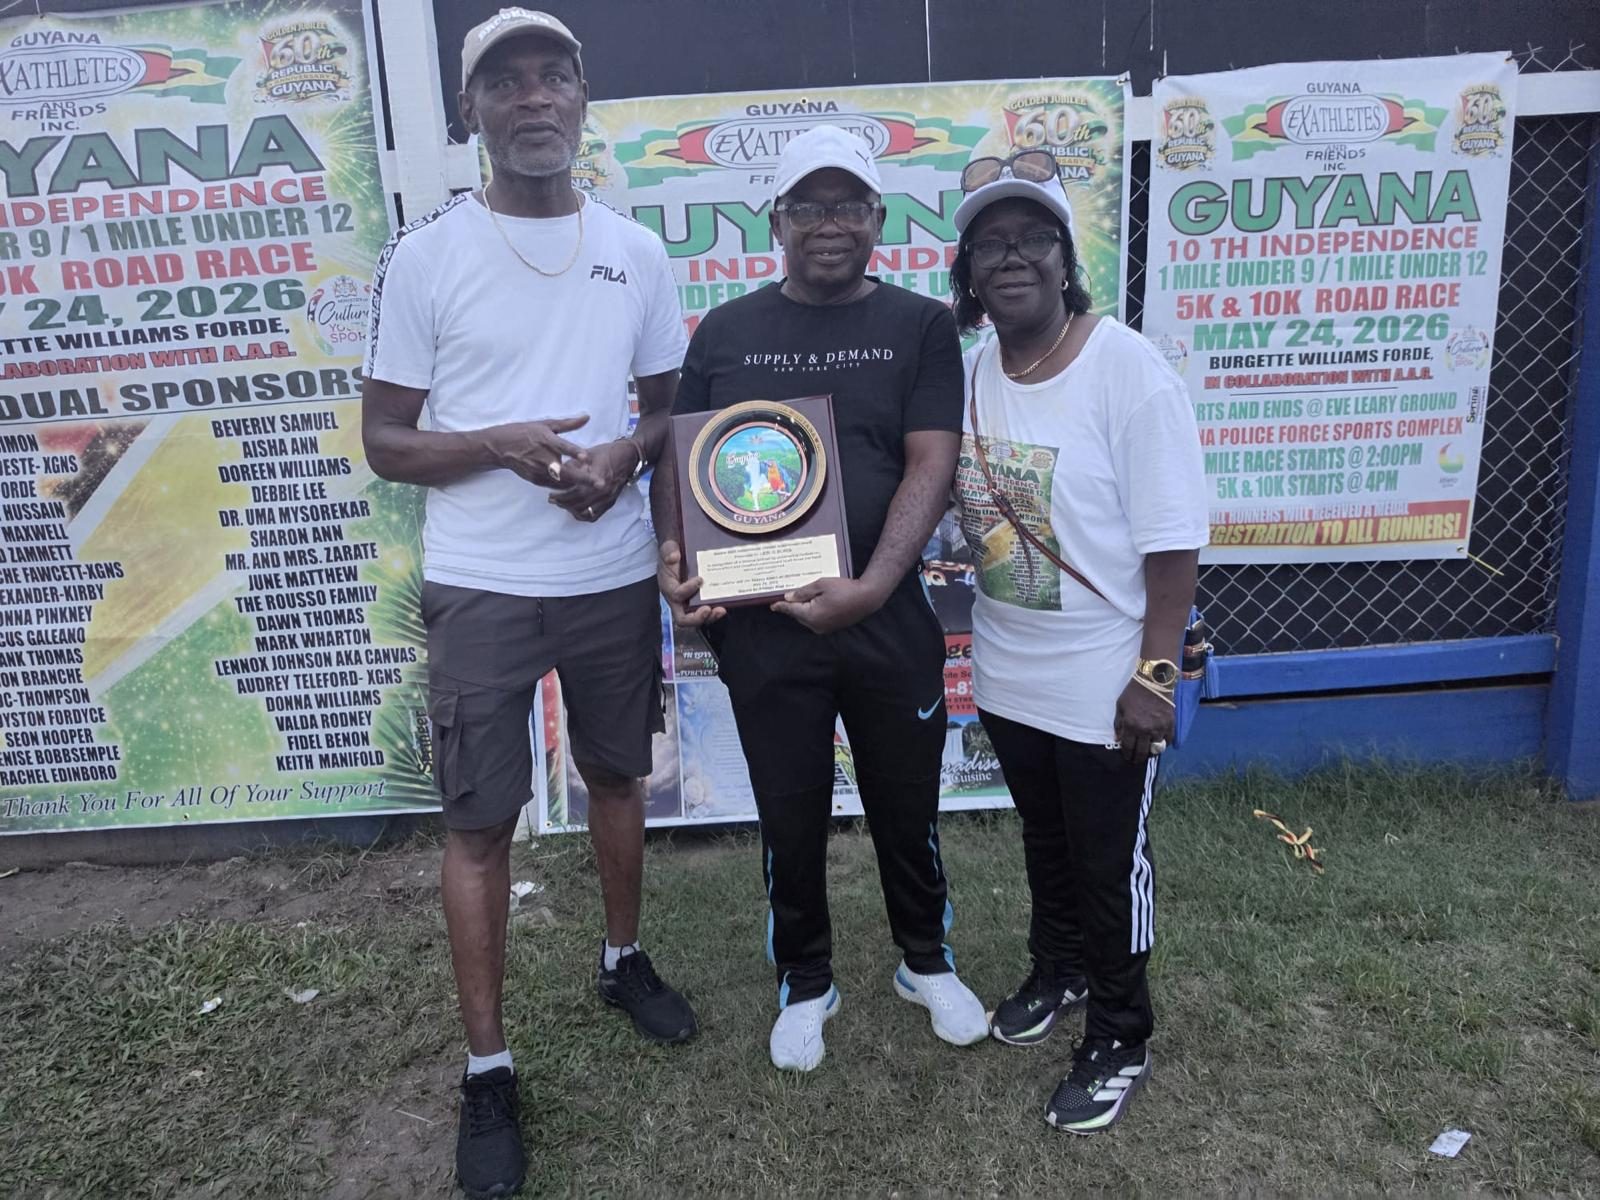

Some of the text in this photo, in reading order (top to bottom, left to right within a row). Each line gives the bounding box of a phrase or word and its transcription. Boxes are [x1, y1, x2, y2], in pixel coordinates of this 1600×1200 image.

[11, 31, 101, 47] GUYANA
[271, 64, 334, 79] REPUBLIC
[272, 80, 336, 96] GUYANA
[1306, 82, 1362, 93] GUYANA
[11, 103, 107, 120] FRIENDS
[745, 101, 839, 116] GUYANA
[41, 121, 80, 131] INC.
[1014, 105, 1090, 148] 60th
[1288, 104, 1381, 137] EXATHLETES
[1306, 149, 1366, 160] FRIENDS
[1168, 170, 1482, 236] GUYANA
[29, 203, 354, 257] 9 1 MILE UNDER 12
[1168, 226, 1478, 262] 10 TH INDEPENDENCE
[61, 242, 317, 290] ROAD RACE
[590, 265, 627, 285] FILA
[1158, 251, 1488, 290] 1 MILE UNDER 9 1 MILE UNDER 12
[24, 278, 306, 331] 24, 2026
[1177, 283, 1461, 320] 5K & 10K ROAD RACE
[54, 317, 290, 350] WILLIAMS FORDE,
[1194, 313, 1449, 351] MAY 24, 2026
[149, 341, 296, 368] WITH A.A.G.
[744, 349, 893, 366] SUPPLY & DEMAND
[1210, 347, 1433, 369] BURGETTE WILLIAMS FORDE,
[1205, 375, 1220, 389] IN
[1224, 370, 1348, 388] COLLABORATION
[1352, 368, 1391, 383] WITH
[1228, 401, 1259, 420] AND
[1263, 400, 1302, 418] ENDS
[1306, 398, 1323, 417] @
[1326, 397, 1351, 416] EVE
[1354, 395, 1397, 415] LEARY
[1400, 392, 1457, 413] GROUND
[211, 412, 339, 439] BEVERLY SAMUEL
[1220, 426, 1274, 445] POLICE
[1279, 424, 1329, 443] FORCE
[1333, 421, 1392, 441] SPORTS
[1397, 417, 1463, 437] COMPLEX
[242, 436, 319, 459] AISHA ANN
[1205, 443, 1423, 474] MILE RACE STARTS @ 2:00PM
[43, 455, 78, 473] XGNS
[218, 457, 352, 483] DOREEN WILLIAMS
[251, 482, 327, 503] DEBBIE LEE
[1217, 470, 1398, 498] 5K & 10K STARTS @ 4PM
[3, 501, 66, 521] HUSSAIN
[218, 500, 371, 528] DR. UMA MYSOREKAR
[733, 511, 786, 524] GUYANA
[2, 523, 69, 543] MAXWELL
[250, 524, 344, 548] SHARON ANN
[1321, 519, 1343, 544] TO
[1345, 518, 1374, 543] ALL
[1377, 513, 1462, 542] RUNNERS!
[8, 544, 73, 563] ZAMMETT
[225, 542, 379, 571] MR. AND MRS. ZARATE
[22, 561, 124, 582] FAWCETT-XGNS
[248, 565, 358, 592] JUNE MATTHEW
[234, 585, 378, 614] THE ROUSSO FAMILY
[36, 605, 93, 625] PINKNEY
[256, 607, 365, 632] DAWN THOMAS
[27, 627, 86, 645] GALEANO
[255, 628, 371, 652] MARK WHARTON
[28, 648, 84, 666] THOMAS
[215, 646, 417, 676] LENNOX JOHNSON AKA CANVAS
[22, 668, 84, 686] BRANCHE
[236, 668, 403, 695] AUDREY TELEFORD- XGNS
[265, 689, 382, 713] DONNA WILLIAMS
[48, 707, 106, 726] FORDYCE
[275, 710, 372, 732] VALDA RODNEY
[5, 728, 94, 748] SEON HOOPER
[287, 731, 370, 751] FIDEL BENON
[36, 745, 121, 765] BOBBSEMPLE
[275, 750, 385, 772] KEITH MANIFOLD
[0, 765, 117, 786] RACHEL EDINBORO
[952, 771, 993, 784] Cuisine
[4, 779, 385, 818] Thank You For All Of Your Support
